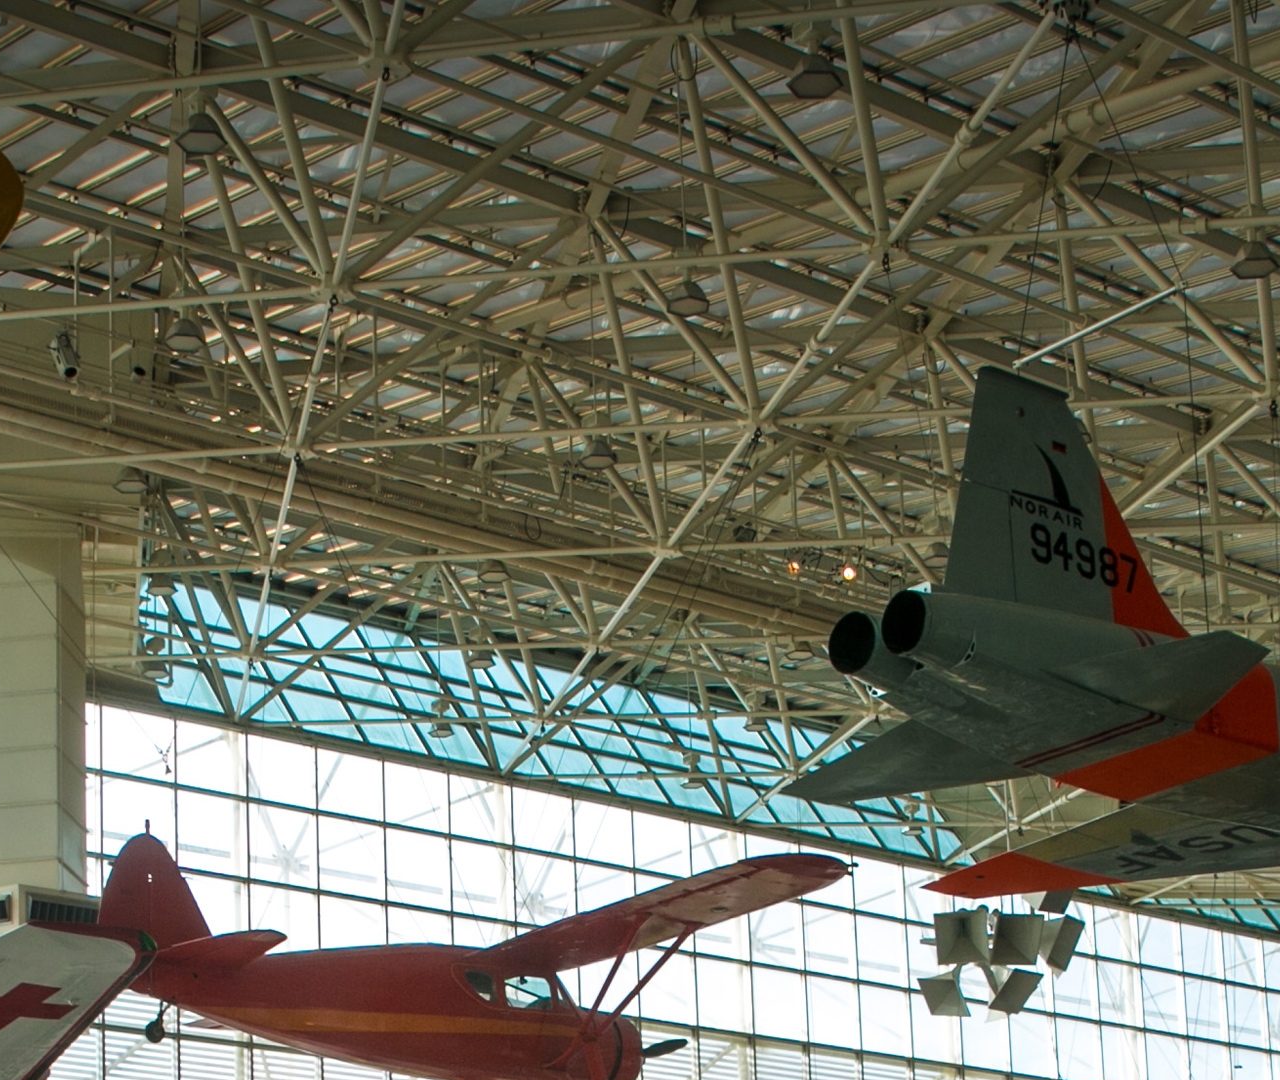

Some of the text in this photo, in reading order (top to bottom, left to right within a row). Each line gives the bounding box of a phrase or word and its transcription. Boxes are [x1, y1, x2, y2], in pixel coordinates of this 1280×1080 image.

[1010, 496, 1084, 531] NORAIR
[1031, 523, 1138, 593] 94987
[1115, 824, 1280, 875] USAF
